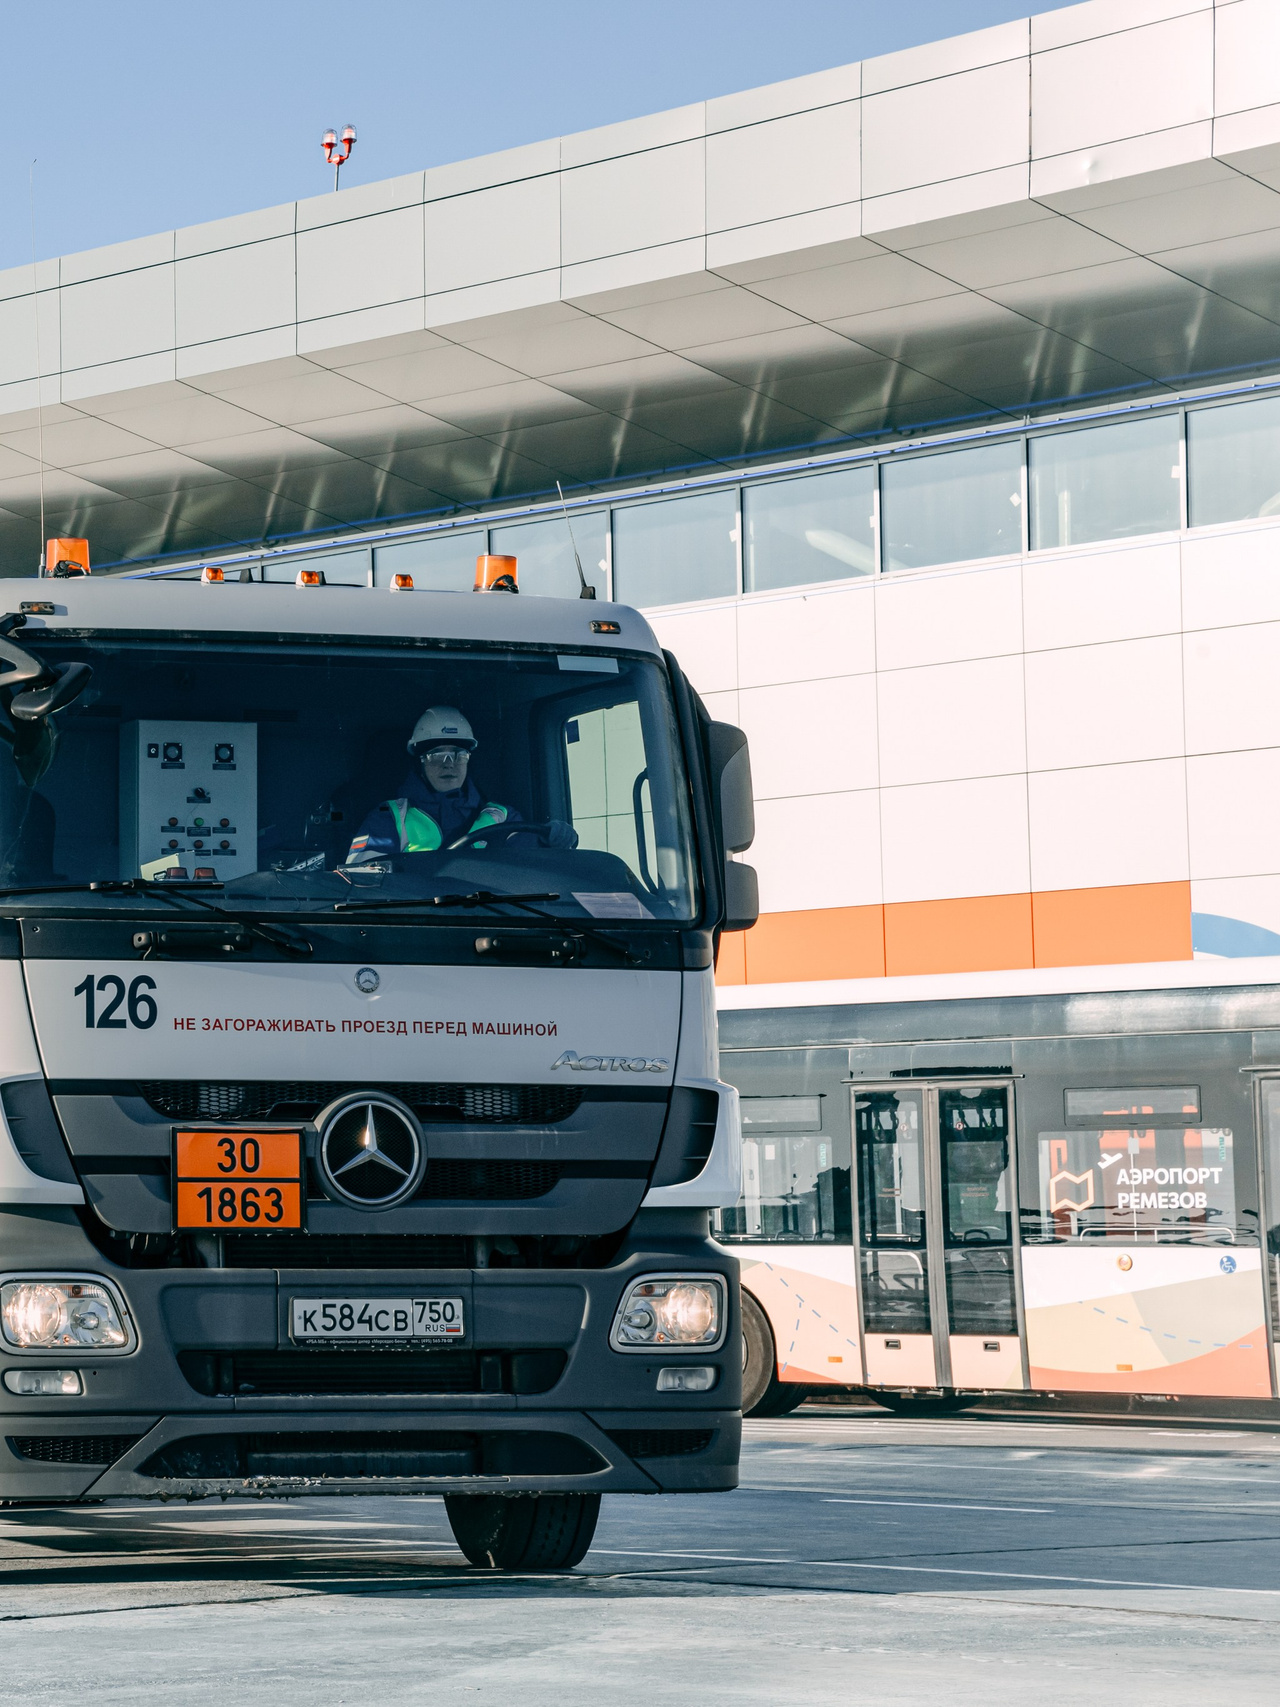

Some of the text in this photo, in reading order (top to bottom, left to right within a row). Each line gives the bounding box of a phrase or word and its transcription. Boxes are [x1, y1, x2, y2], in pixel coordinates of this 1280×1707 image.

[74, 974, 158, 1030] 126
[173, 1017, 558, 1037] НЕ ЗАГОРАЖИВАТЬ ПРОЕЗД ПЕРЕД МАШИНОЙ
[217, 1137, 260, 1174] 30
[1116, 1167, 1223, 1185] АЭРОПОРТ
[196, 1186, 284, 1223] 1863
[1118, 1192, 1208, 1209] РЕМЕЗОВ
[303, 1301, 455, 1332] К584СВ 750
[425, 1324, 445, 1332] RUS
